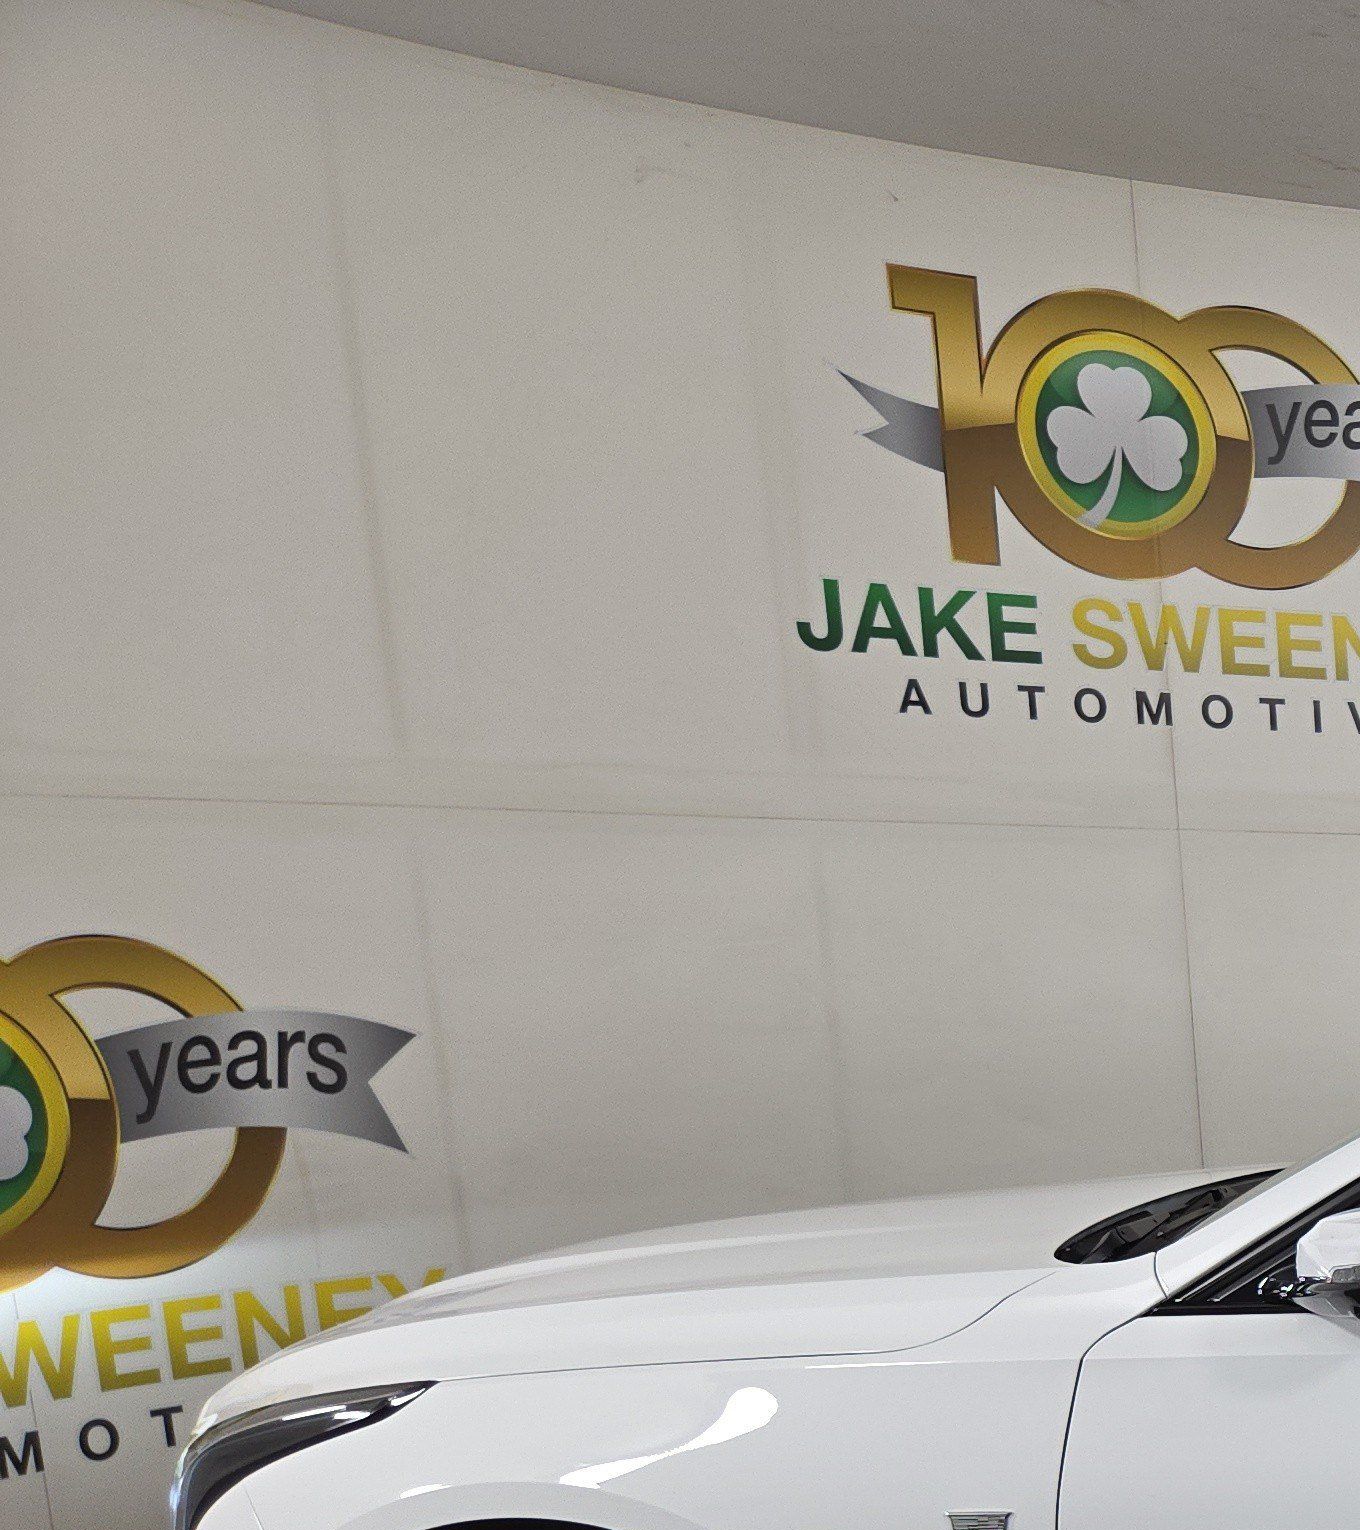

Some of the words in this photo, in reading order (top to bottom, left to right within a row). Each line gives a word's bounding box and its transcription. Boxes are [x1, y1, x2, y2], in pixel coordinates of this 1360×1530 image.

[796, 577, 1044, 665] JAKE
[127, 1029, 349, 1123] years
[0, 1268, 446, 1408] WEENE
